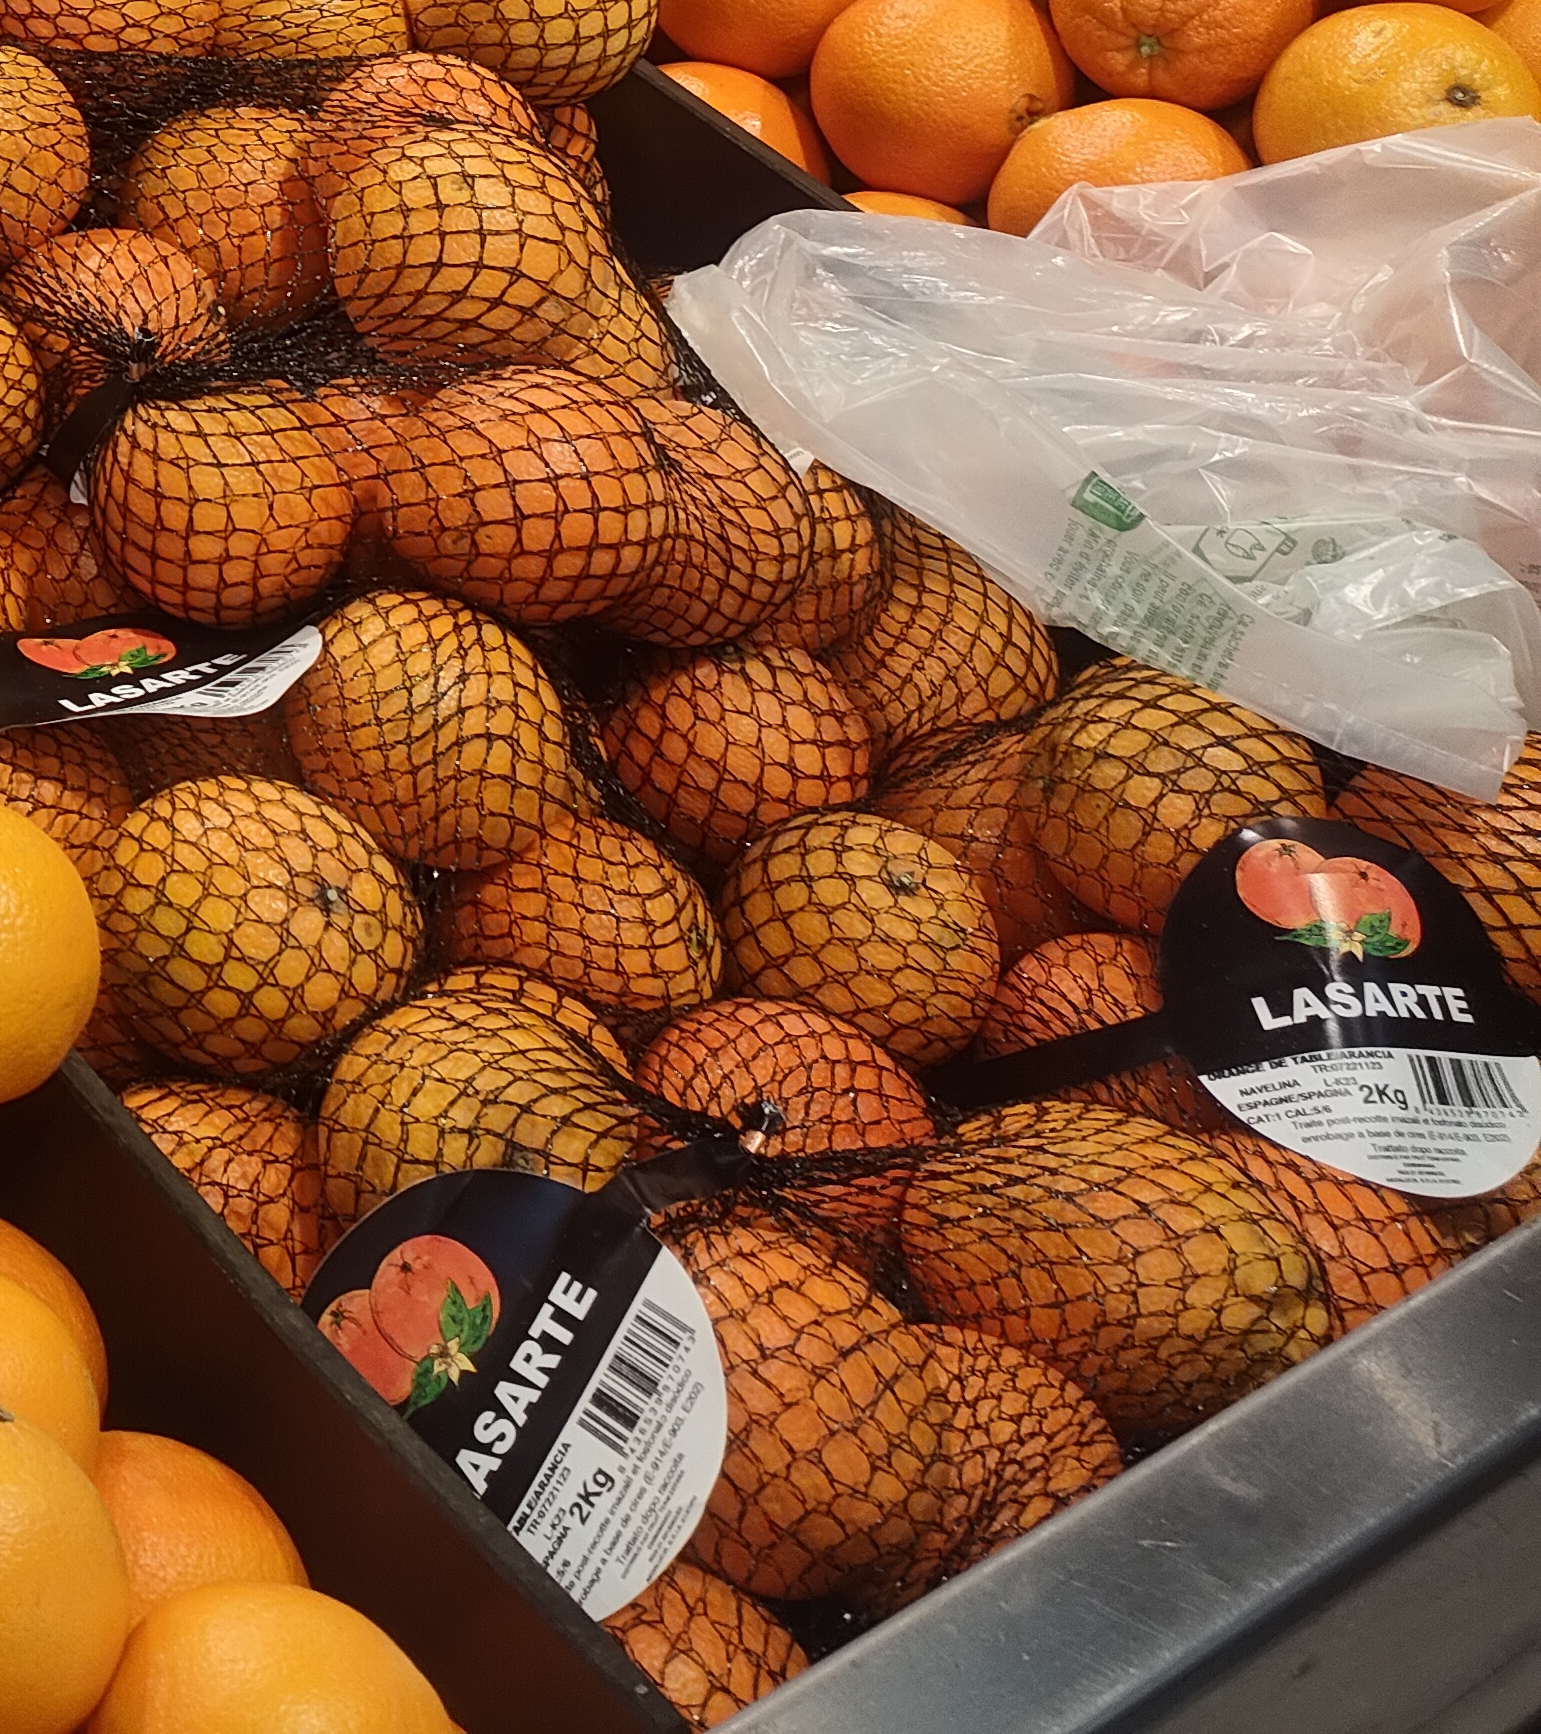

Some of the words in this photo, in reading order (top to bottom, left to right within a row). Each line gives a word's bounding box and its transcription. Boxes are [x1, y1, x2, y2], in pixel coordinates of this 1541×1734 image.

[57, 652, 249, 714] LASARTE
[1251, 982, 1475, 1032] LASARTE
[1358, 1084, 1407, 1111] 2Kg
[454, 1271, 599, 1499] ASARTE
[569, 1466, 616, 1526] 2Kg
